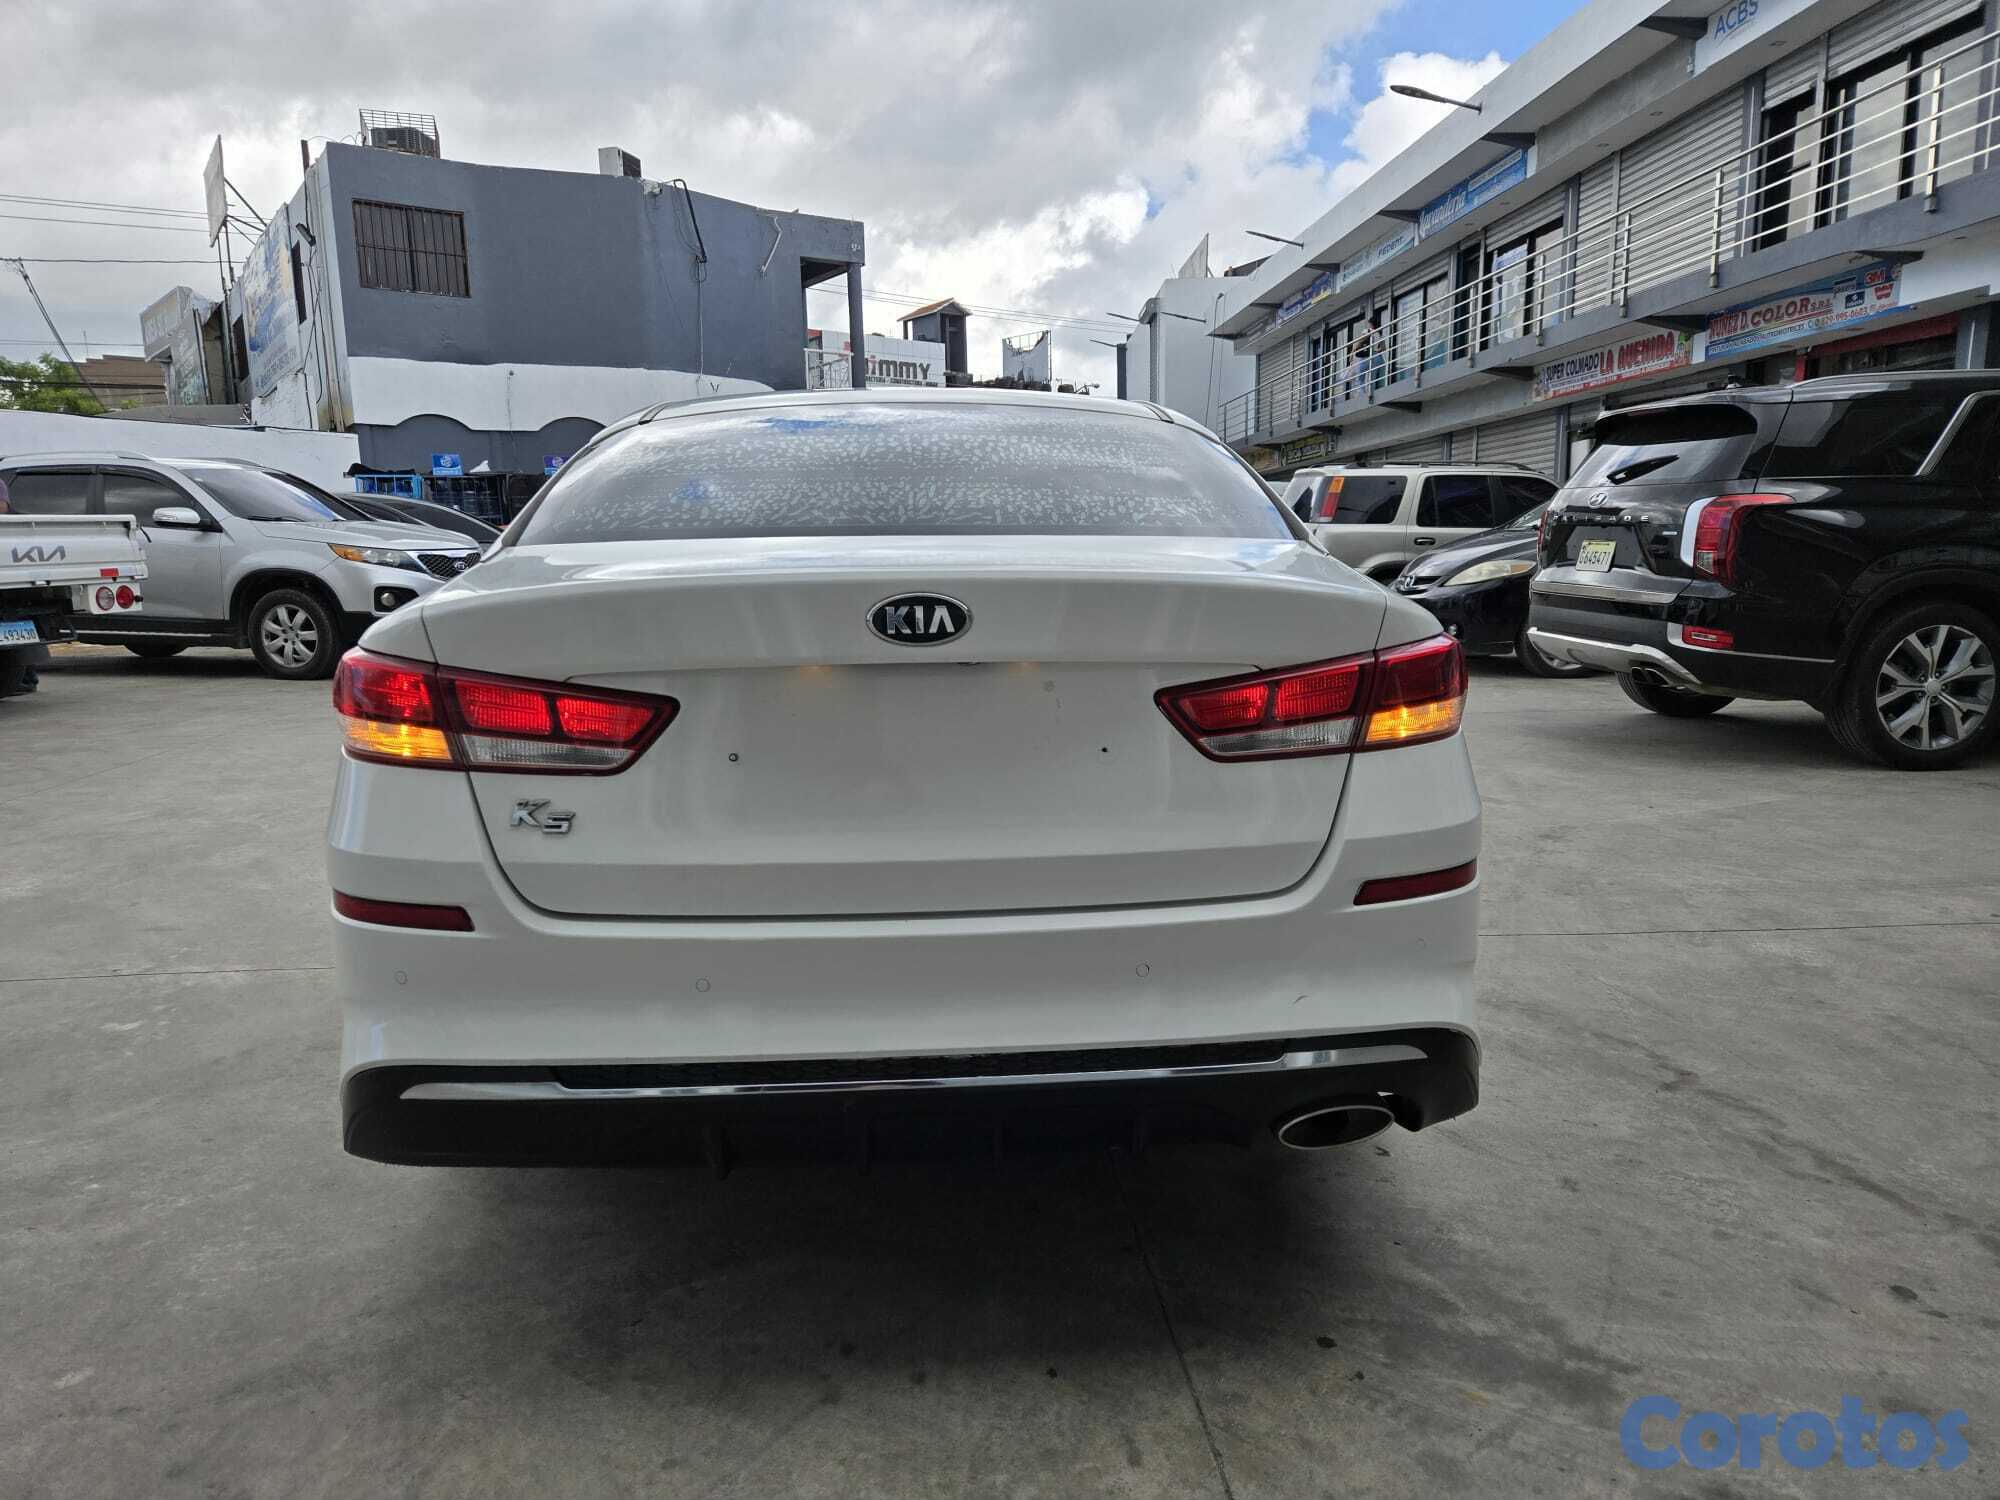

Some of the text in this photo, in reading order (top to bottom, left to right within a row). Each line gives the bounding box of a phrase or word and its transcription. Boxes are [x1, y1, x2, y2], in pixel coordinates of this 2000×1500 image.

[1713, 0, 1760, 40] ACBS
[1751, 297, 1810, 328] COLOR
[1546, 363, 1564, 382] SUPER
[1565, 353, 1599, 377] COLMADO
[1600, 349, 1614, 375] LA
[885, 605, 956, 635] KIA
